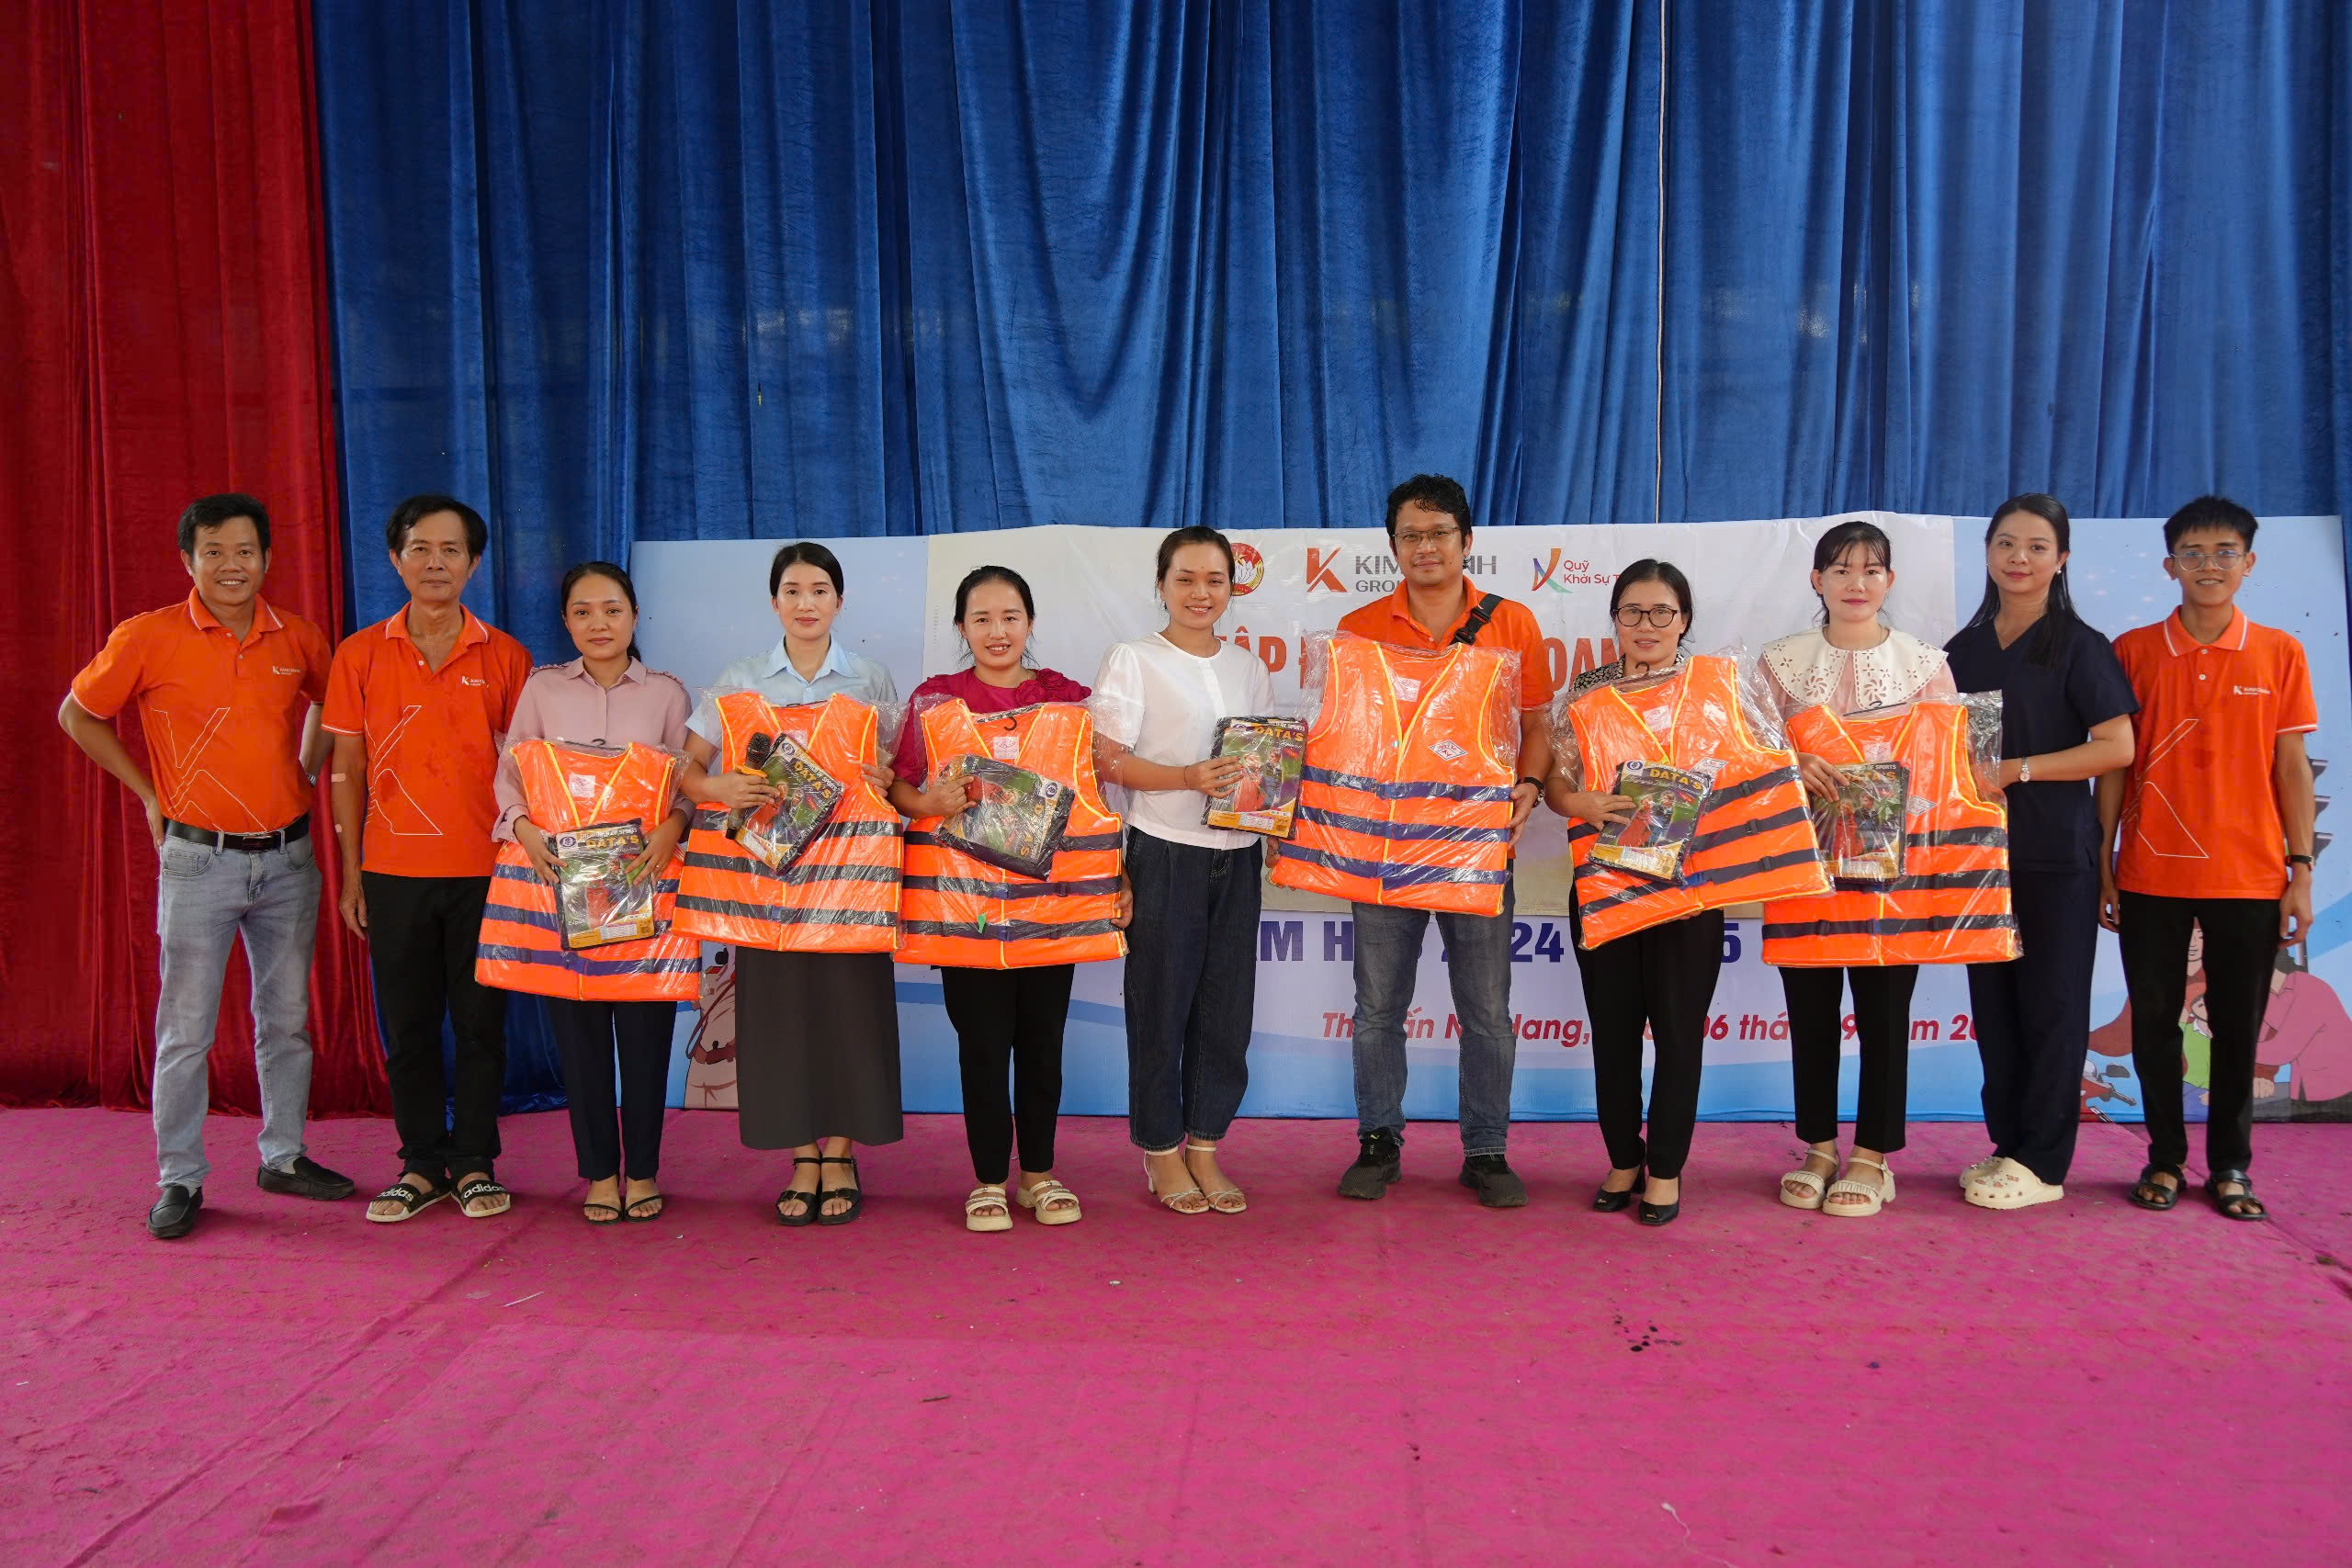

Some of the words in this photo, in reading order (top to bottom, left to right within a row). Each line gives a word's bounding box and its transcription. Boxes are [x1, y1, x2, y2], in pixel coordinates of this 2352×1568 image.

[1564, 559, 1589, 572] Quỹ
[1564, 574, 1591, 584] Khởi
[1594, 574, 1611, 586] Sự
[1254, 726, 1304, 742] DATA'S
[1649, 769, 1703, 790] DATA'S
[586, 835, 640, 849] DATA'S
[378, 1186, 413, 1202] adidas
